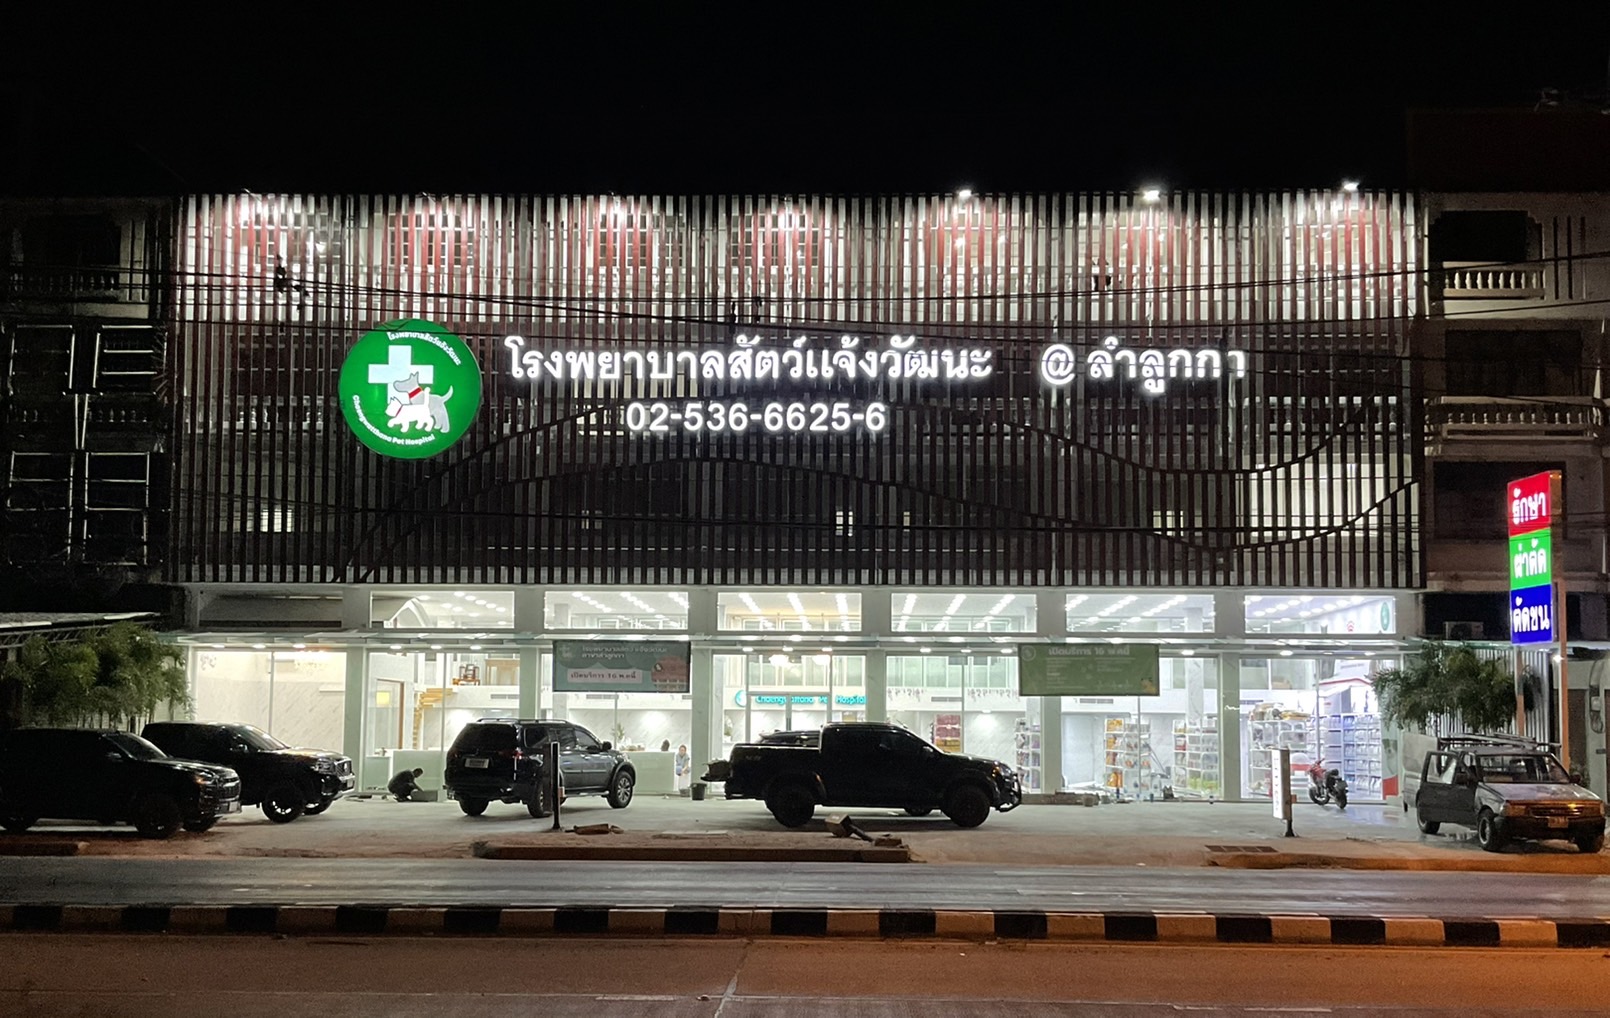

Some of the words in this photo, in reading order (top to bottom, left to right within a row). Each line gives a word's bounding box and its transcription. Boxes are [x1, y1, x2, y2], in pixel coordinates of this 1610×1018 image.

[505, 334, 992, 379] โรงพยาบาลสัตว์แจ้งวัฒนะ
[1041, 343, 1075, 385] @
[1087, 336, 1246, 393] ลำลูกกา
[626, 402, 887, 432] 02-536-6625-6
[1512, 488, 1546, 524] รักษา
[1513, 538, 1547, 579] ผ่าตัด
[1513, 596, 1550, 633] ตัดขน
